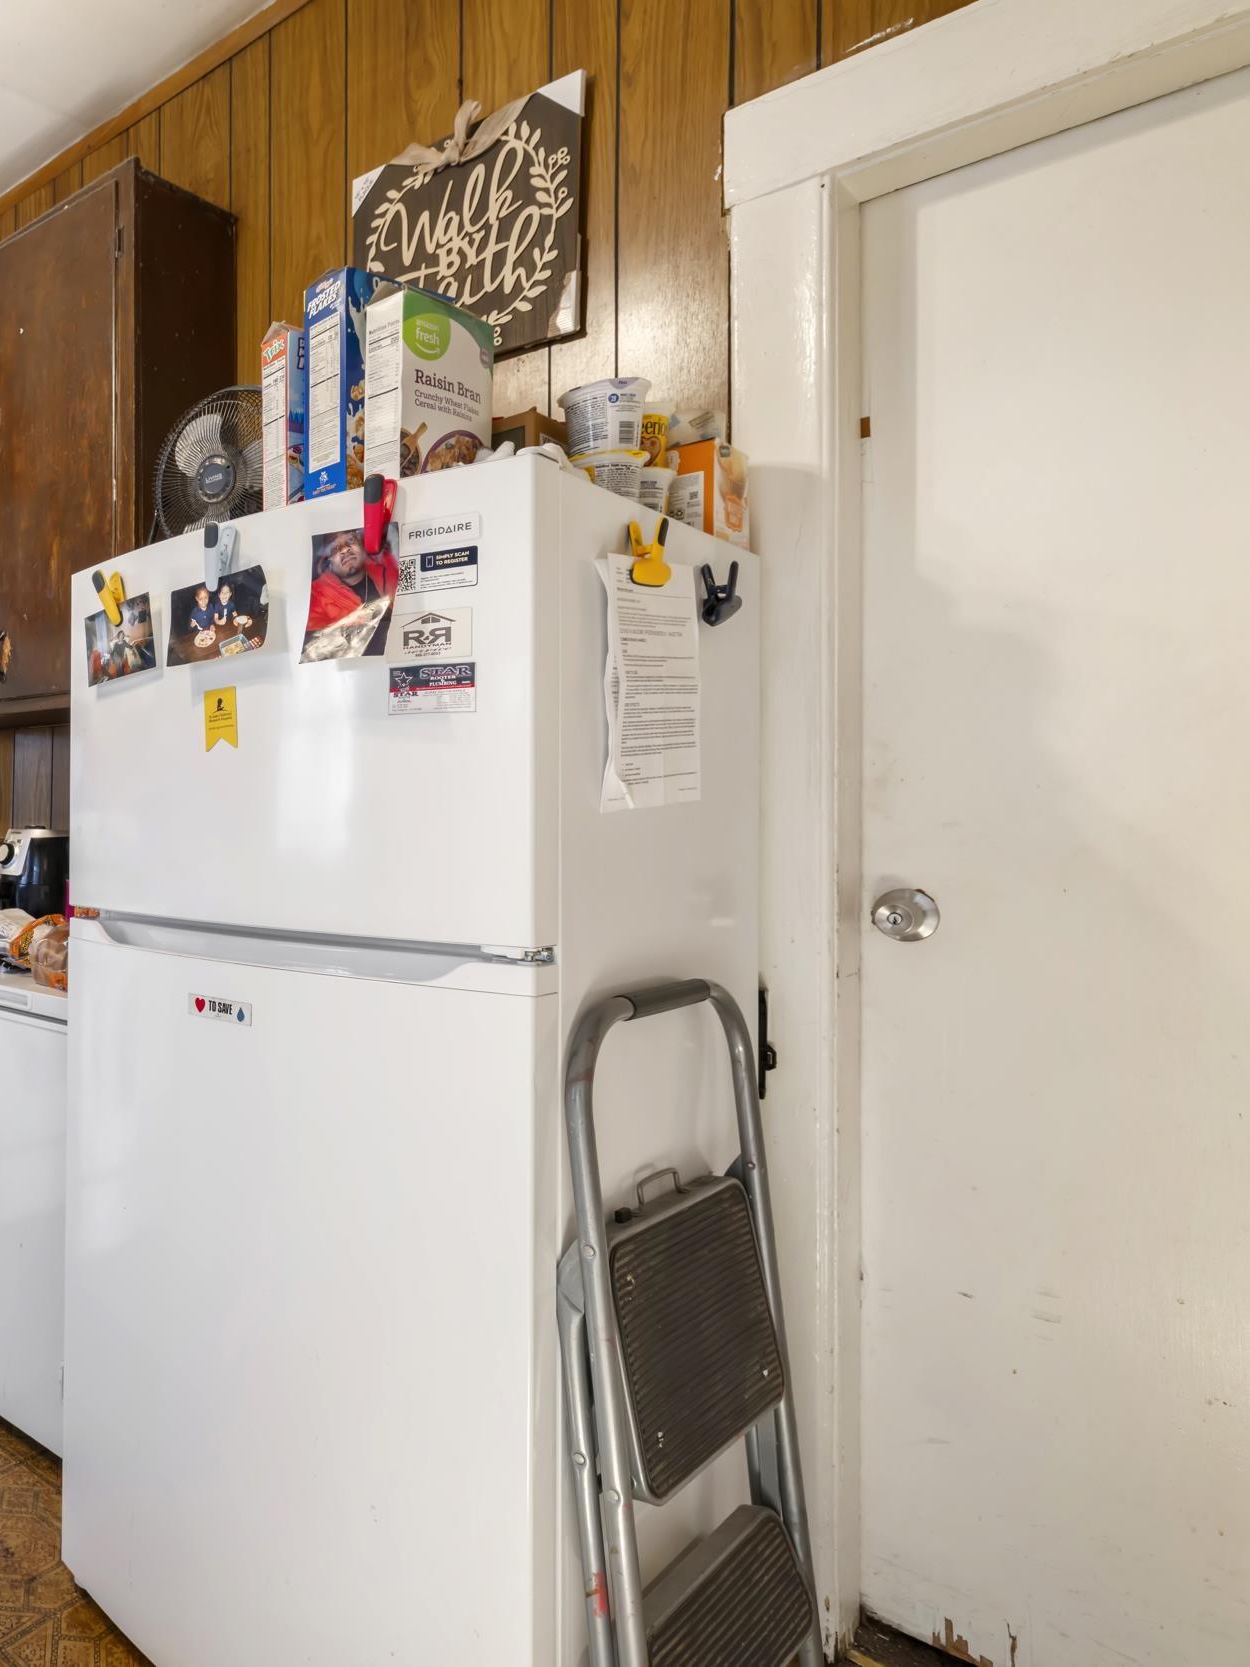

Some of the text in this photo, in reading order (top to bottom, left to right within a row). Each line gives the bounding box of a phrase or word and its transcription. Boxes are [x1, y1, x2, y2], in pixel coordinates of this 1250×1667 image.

[380, 142, 523, 266] Walk
[306, 280, 341, 313] FROSTED
[309, 293, 337, 320] FLAKES
[415, 327, 439, 345] fresh
[262, 340, 285, 362] Trix
[414, 368, 482, 404] Raisin Bran
[414, 388, 444, 405] Crunchy
[444, 397, 463, 410] Wheat
[414, 397, 437, 411] Cereal
[437, 405, 452, 415] with
[408, 521, 473, 540] FRIGIDAIRE
[419, 665, 472, 680] STAR
[208, 1000, 233, 1015] TO SAVE
